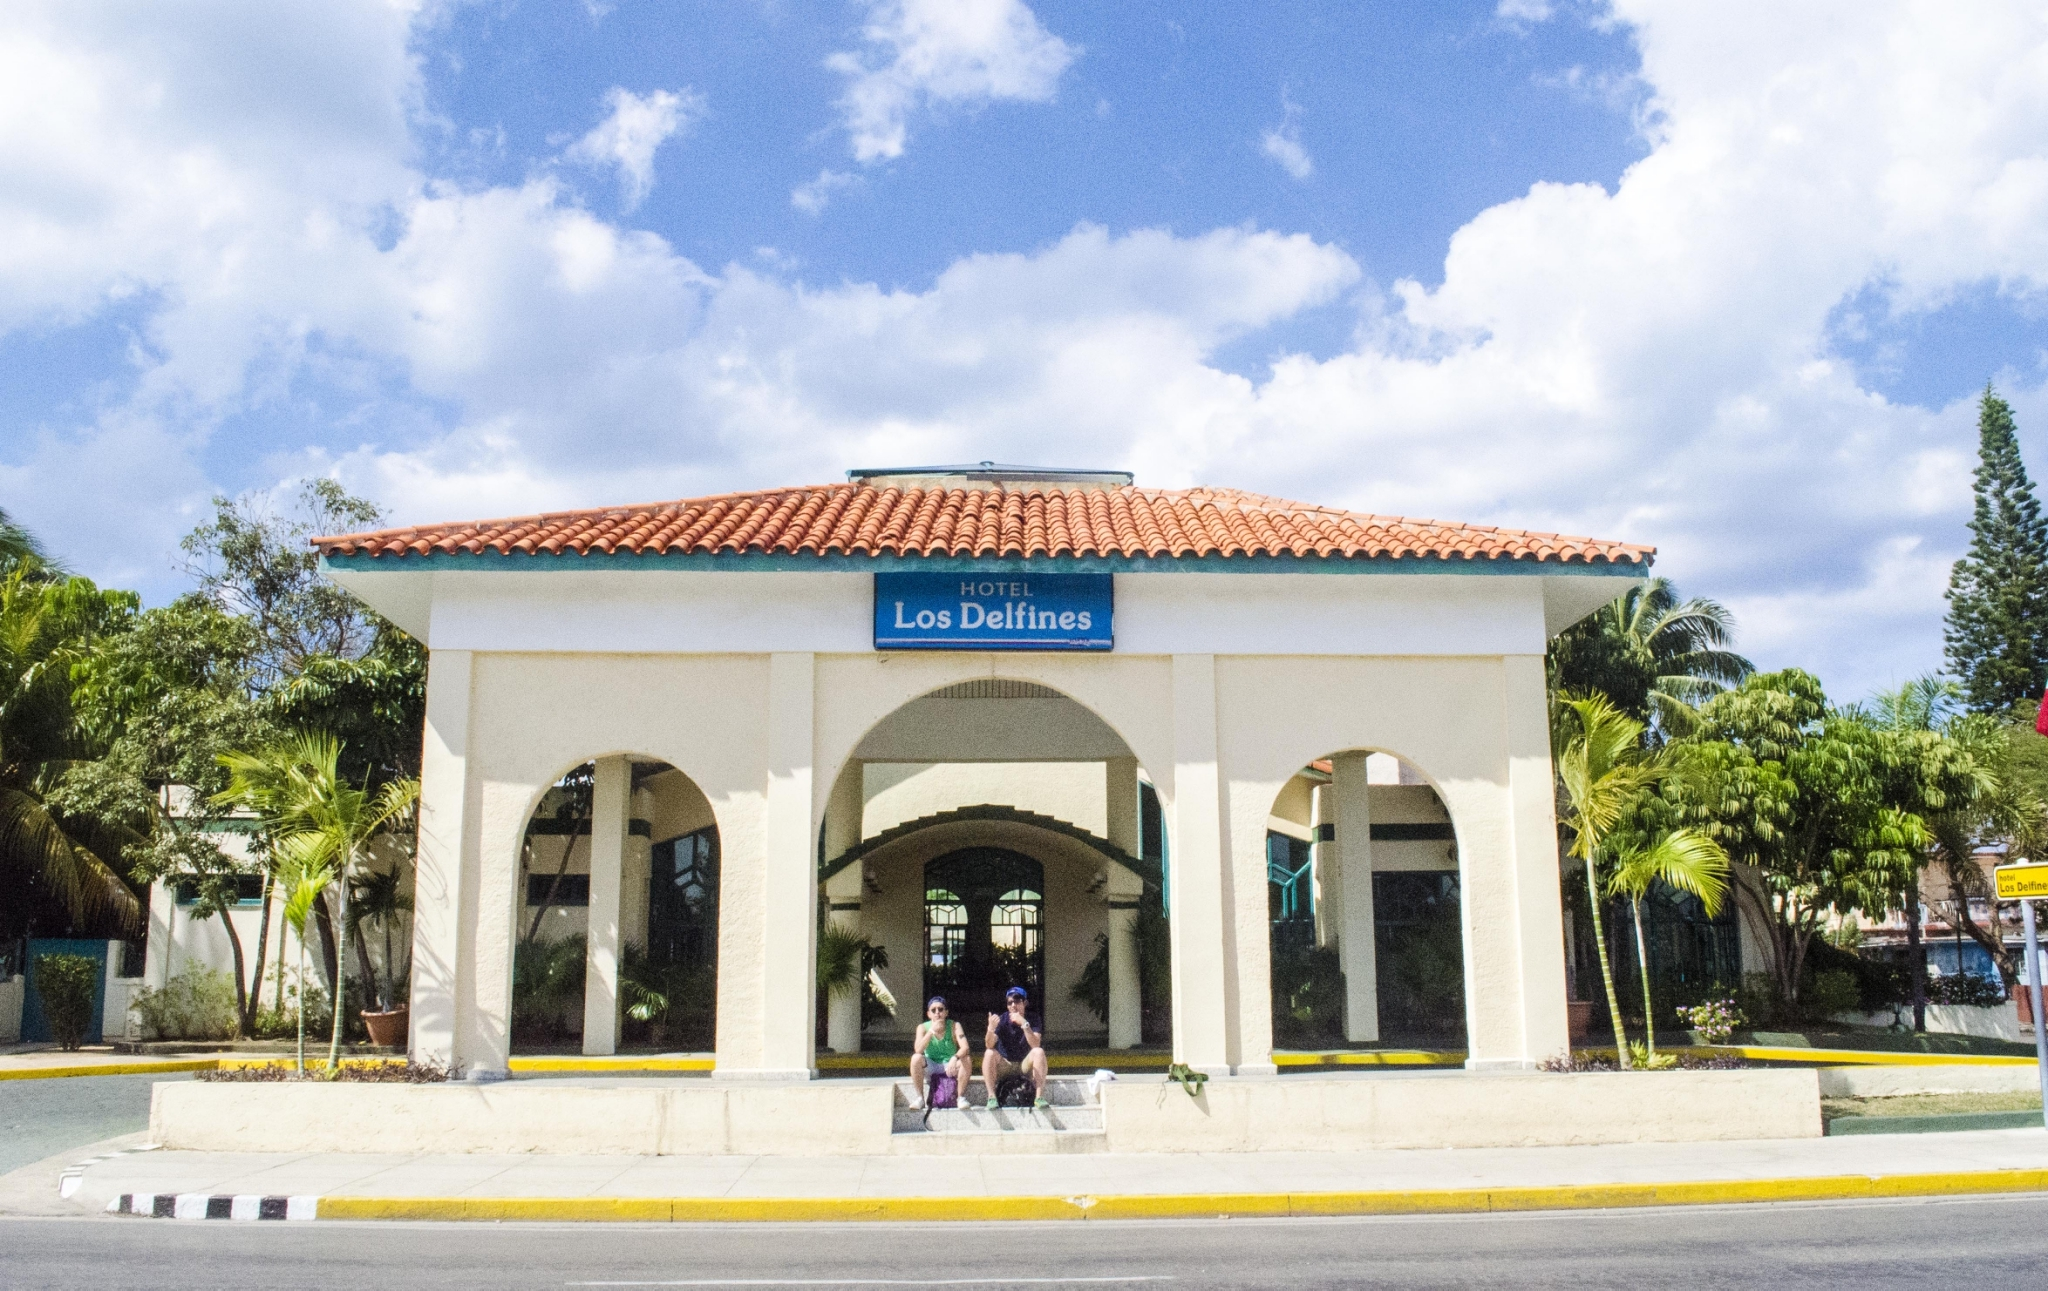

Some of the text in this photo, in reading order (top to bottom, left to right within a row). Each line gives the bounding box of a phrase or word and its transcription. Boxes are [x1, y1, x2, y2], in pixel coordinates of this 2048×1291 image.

[961, 582, 1033, 596] HOTEL
[894, 601, 1092, 630] Los Delfines
[1999, 874, 2016, 882] hotel
[2000, 881, 2048, 892] Los Delfine
